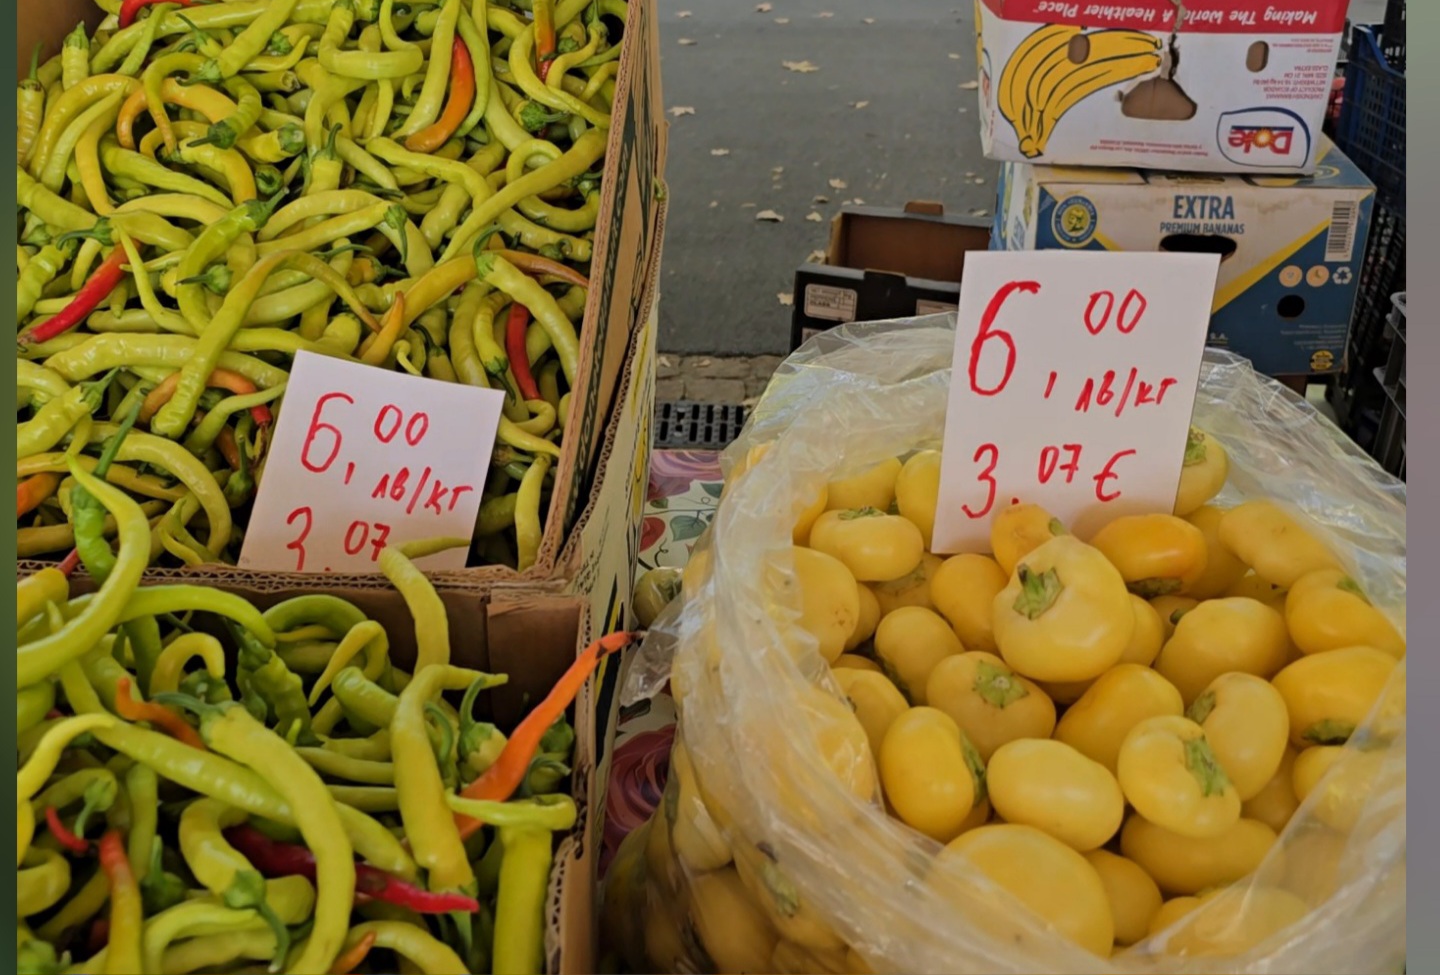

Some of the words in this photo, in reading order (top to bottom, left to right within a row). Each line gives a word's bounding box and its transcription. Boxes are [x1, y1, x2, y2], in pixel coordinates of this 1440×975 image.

[1084, 3, 1156, 22] Healthier
[1162, 8, 1174, 23] A
[1229, 9, 1257, 25] The
[1264, 6, 1318, 25] Making
[1227, 128, 1293, 155] Dole
[1173, 195, 1235, 220] EXTRA
[1160, 222, 1200, 234] PREMIUM
[1203, 222, 1245, 235] BANANAS
